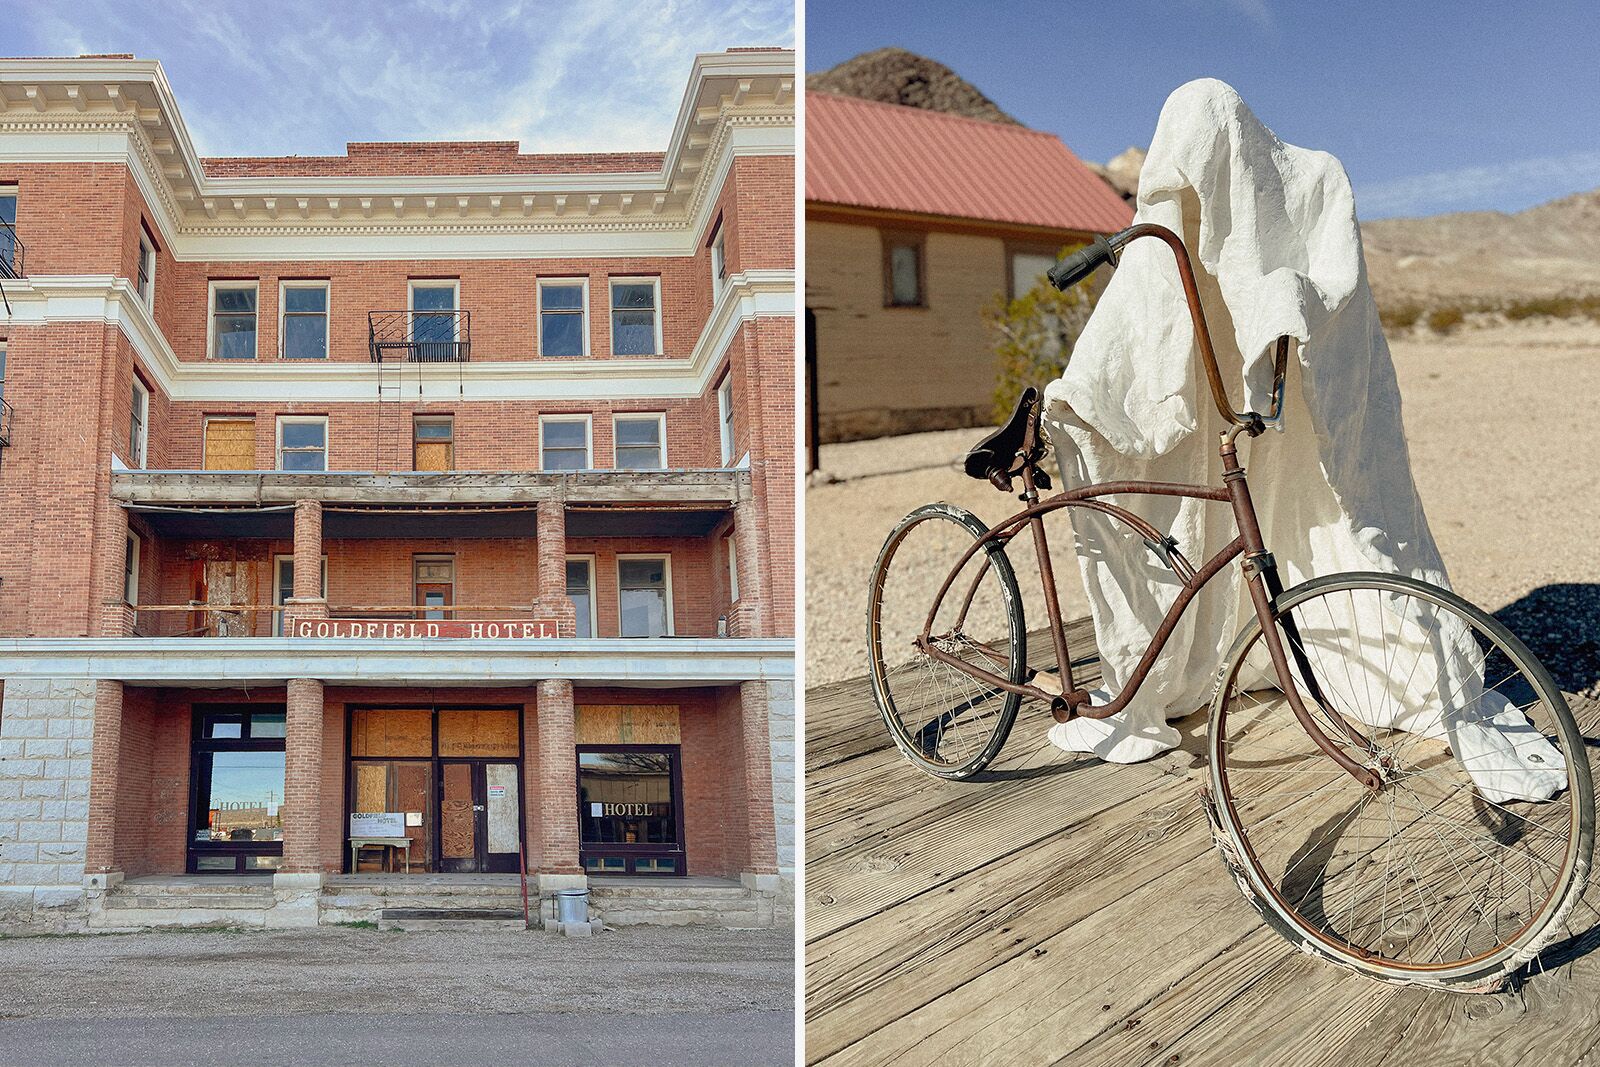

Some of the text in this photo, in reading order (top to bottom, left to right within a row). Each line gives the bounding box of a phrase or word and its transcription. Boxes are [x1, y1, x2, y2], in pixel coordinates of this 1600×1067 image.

[299, 621, 552, 639] GOLDFIELD HOTEL
[220, 801, 266, 812] HOTEL
[604, 803, 653, 816] HOTEL
